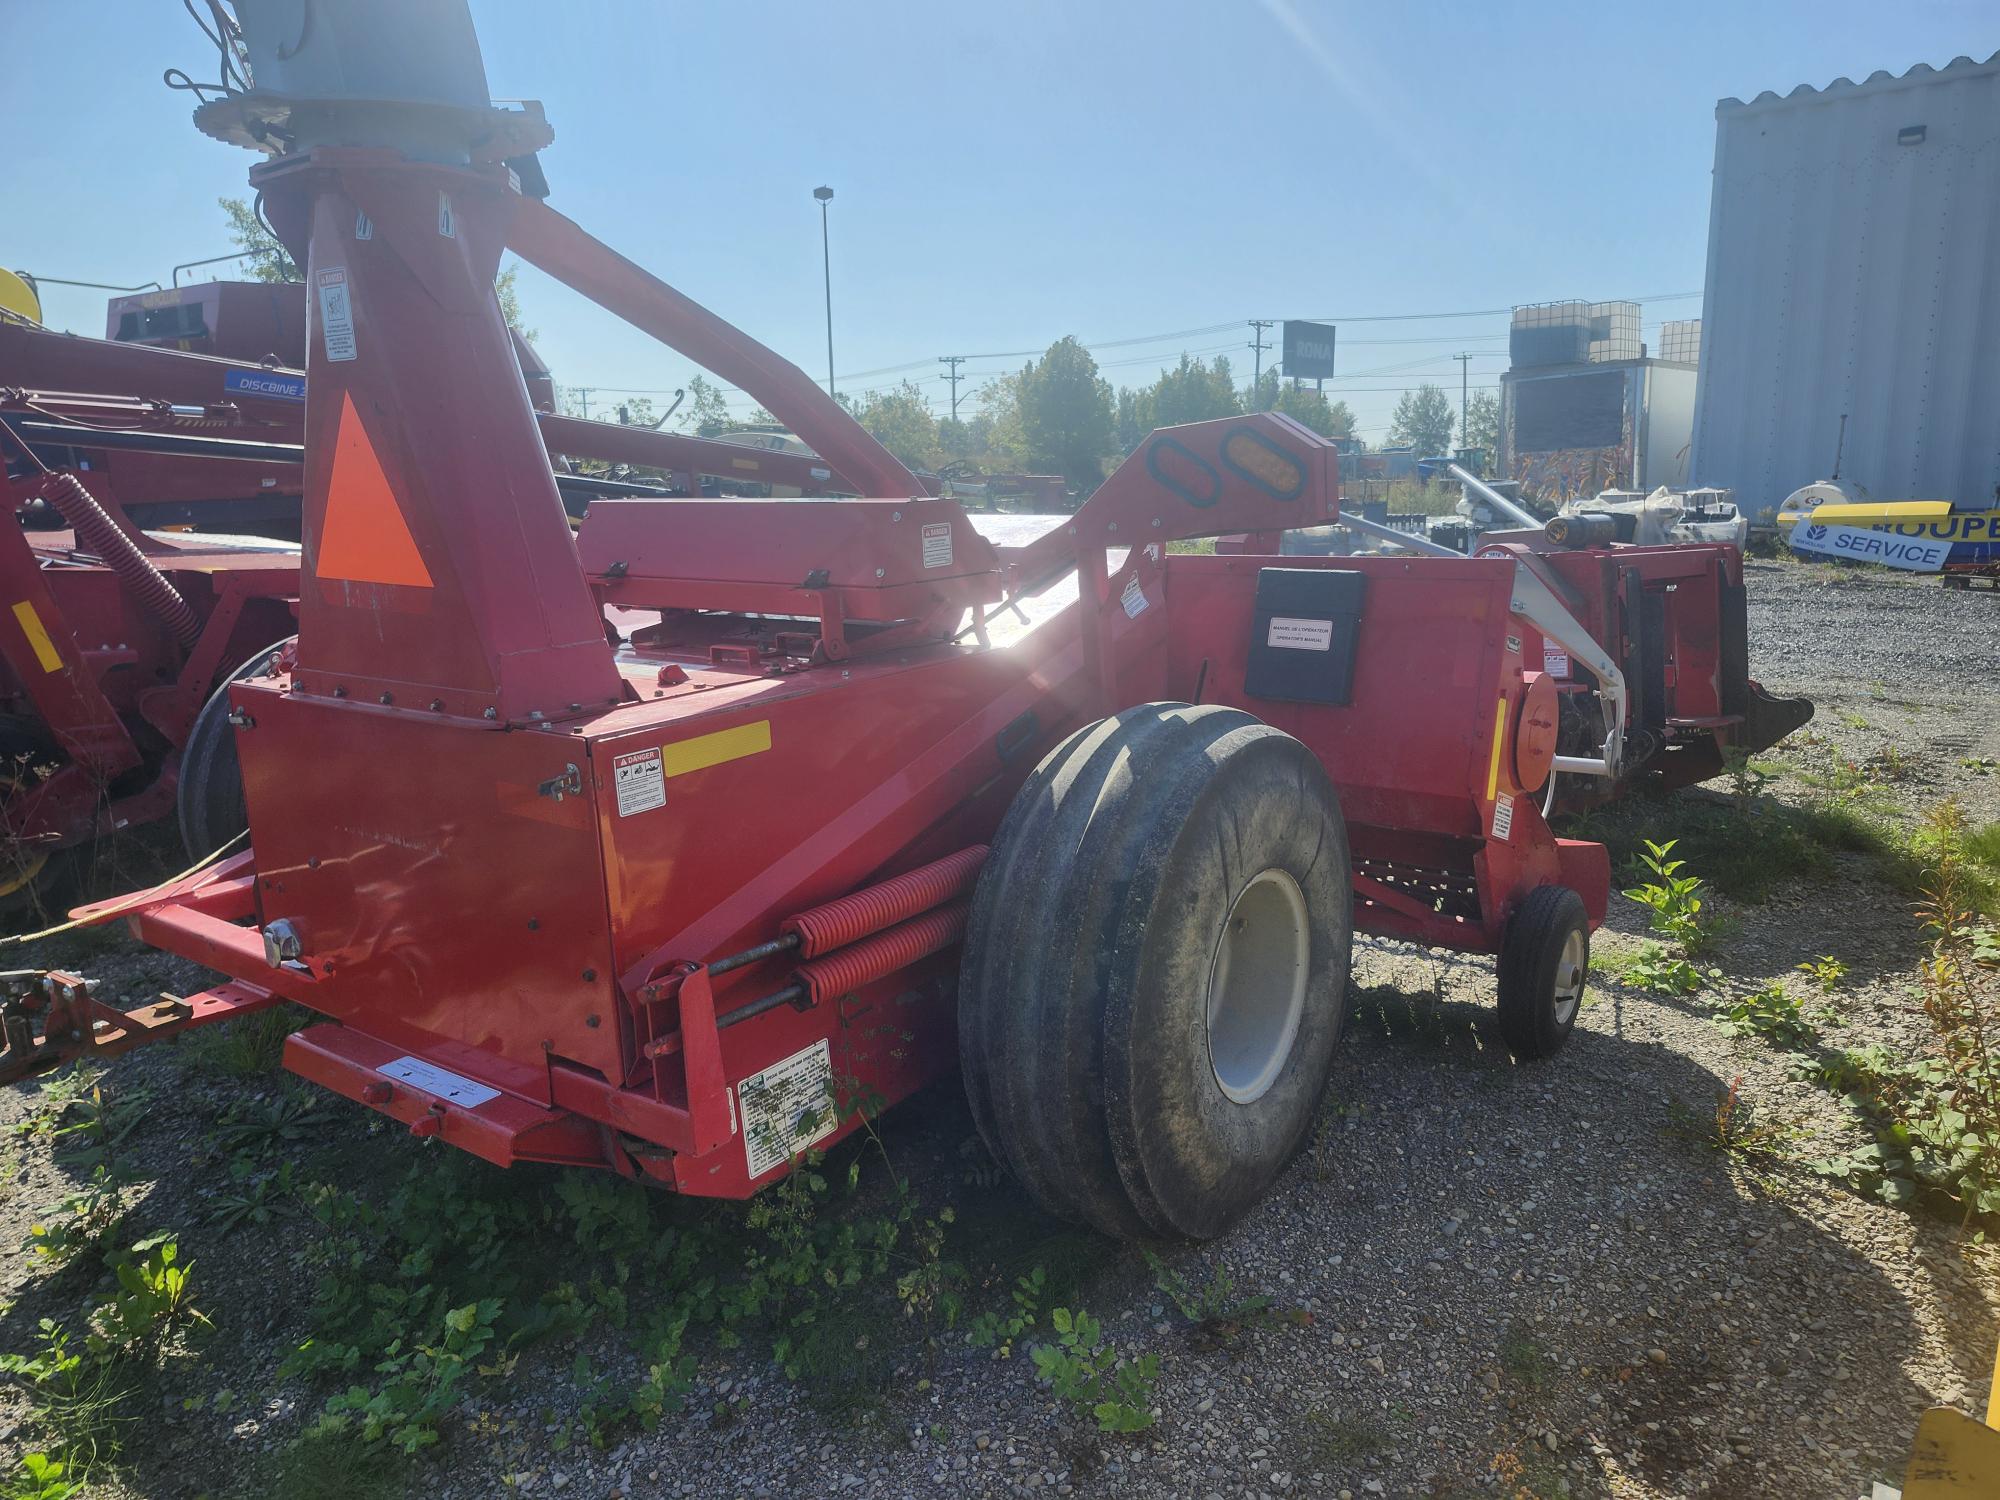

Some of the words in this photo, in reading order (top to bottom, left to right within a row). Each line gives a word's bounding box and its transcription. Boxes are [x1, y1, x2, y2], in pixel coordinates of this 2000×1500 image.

[1296, 341, 1331, 360] RONA
[240, 378, 298, 395] DISCBINE
[1835, 533, 1941, 565] SERVICE
[628, 752, 655, 764] DANGER
